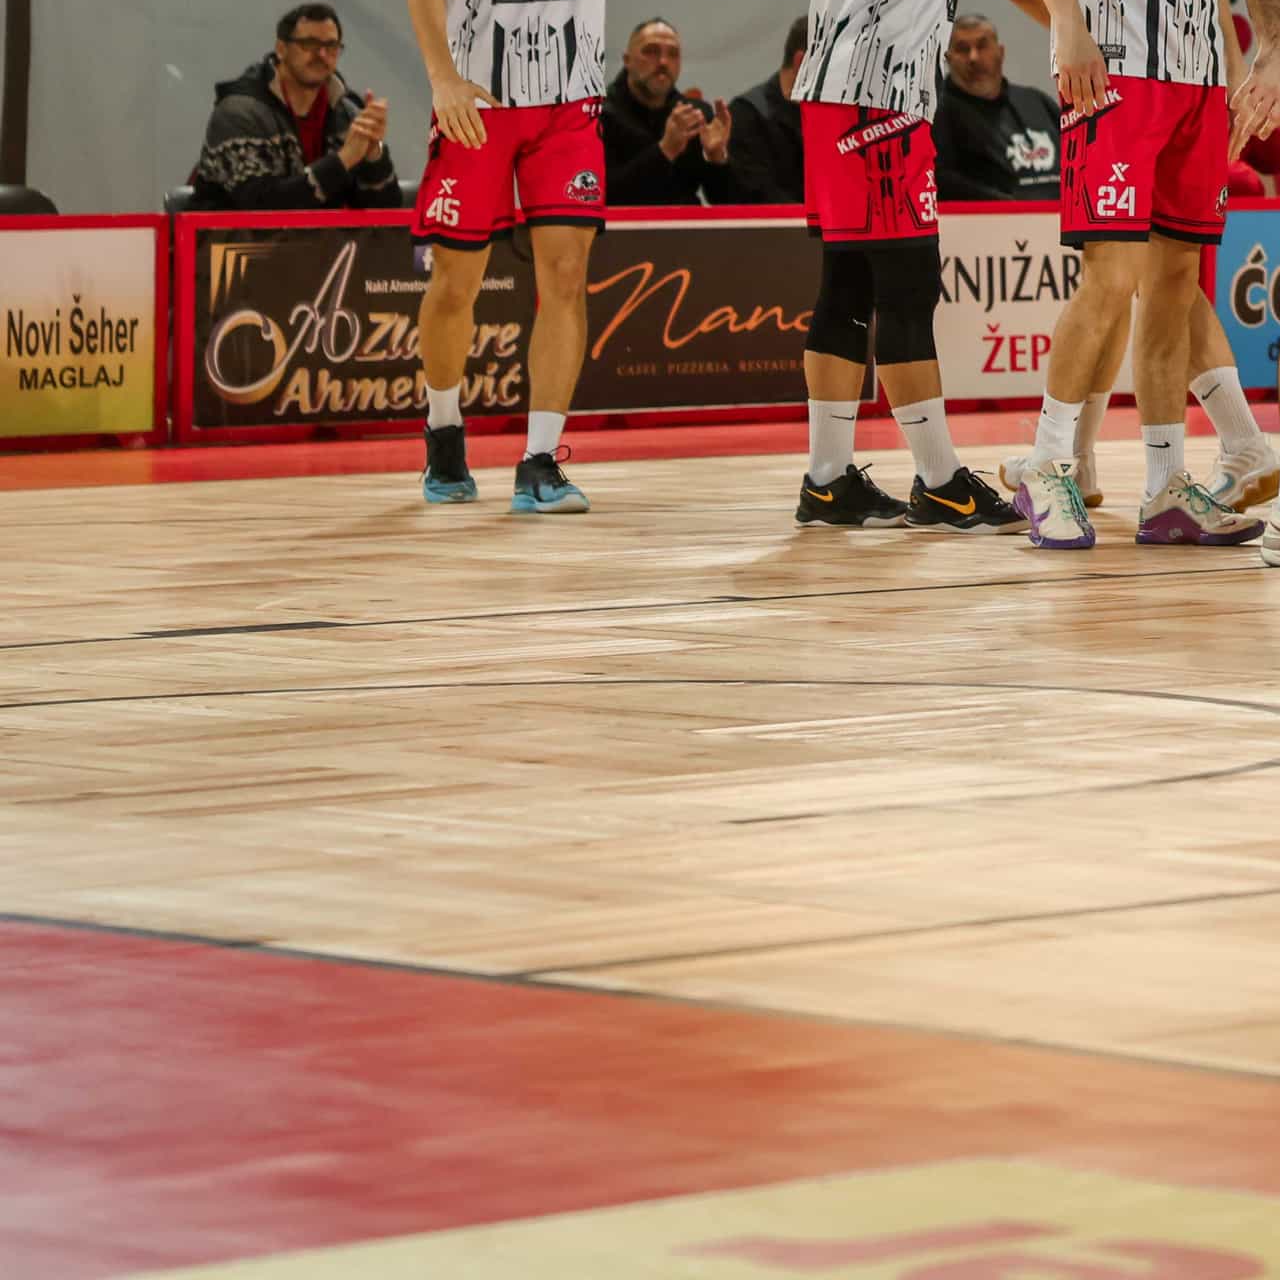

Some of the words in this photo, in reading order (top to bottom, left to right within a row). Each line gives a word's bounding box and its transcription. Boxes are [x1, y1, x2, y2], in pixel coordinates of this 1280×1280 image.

[836, 136, 859, 155] KK
[426, 197, 461, 227] 45
[1097, 185, 1136, 217] 24
[941, 240, 1081, 312] KNJIŽAR
[7, 308, 61, 358] Novi
[69, 293, 139, 355] Šeher
[19, 364, 124, 390] MAGLAJ
